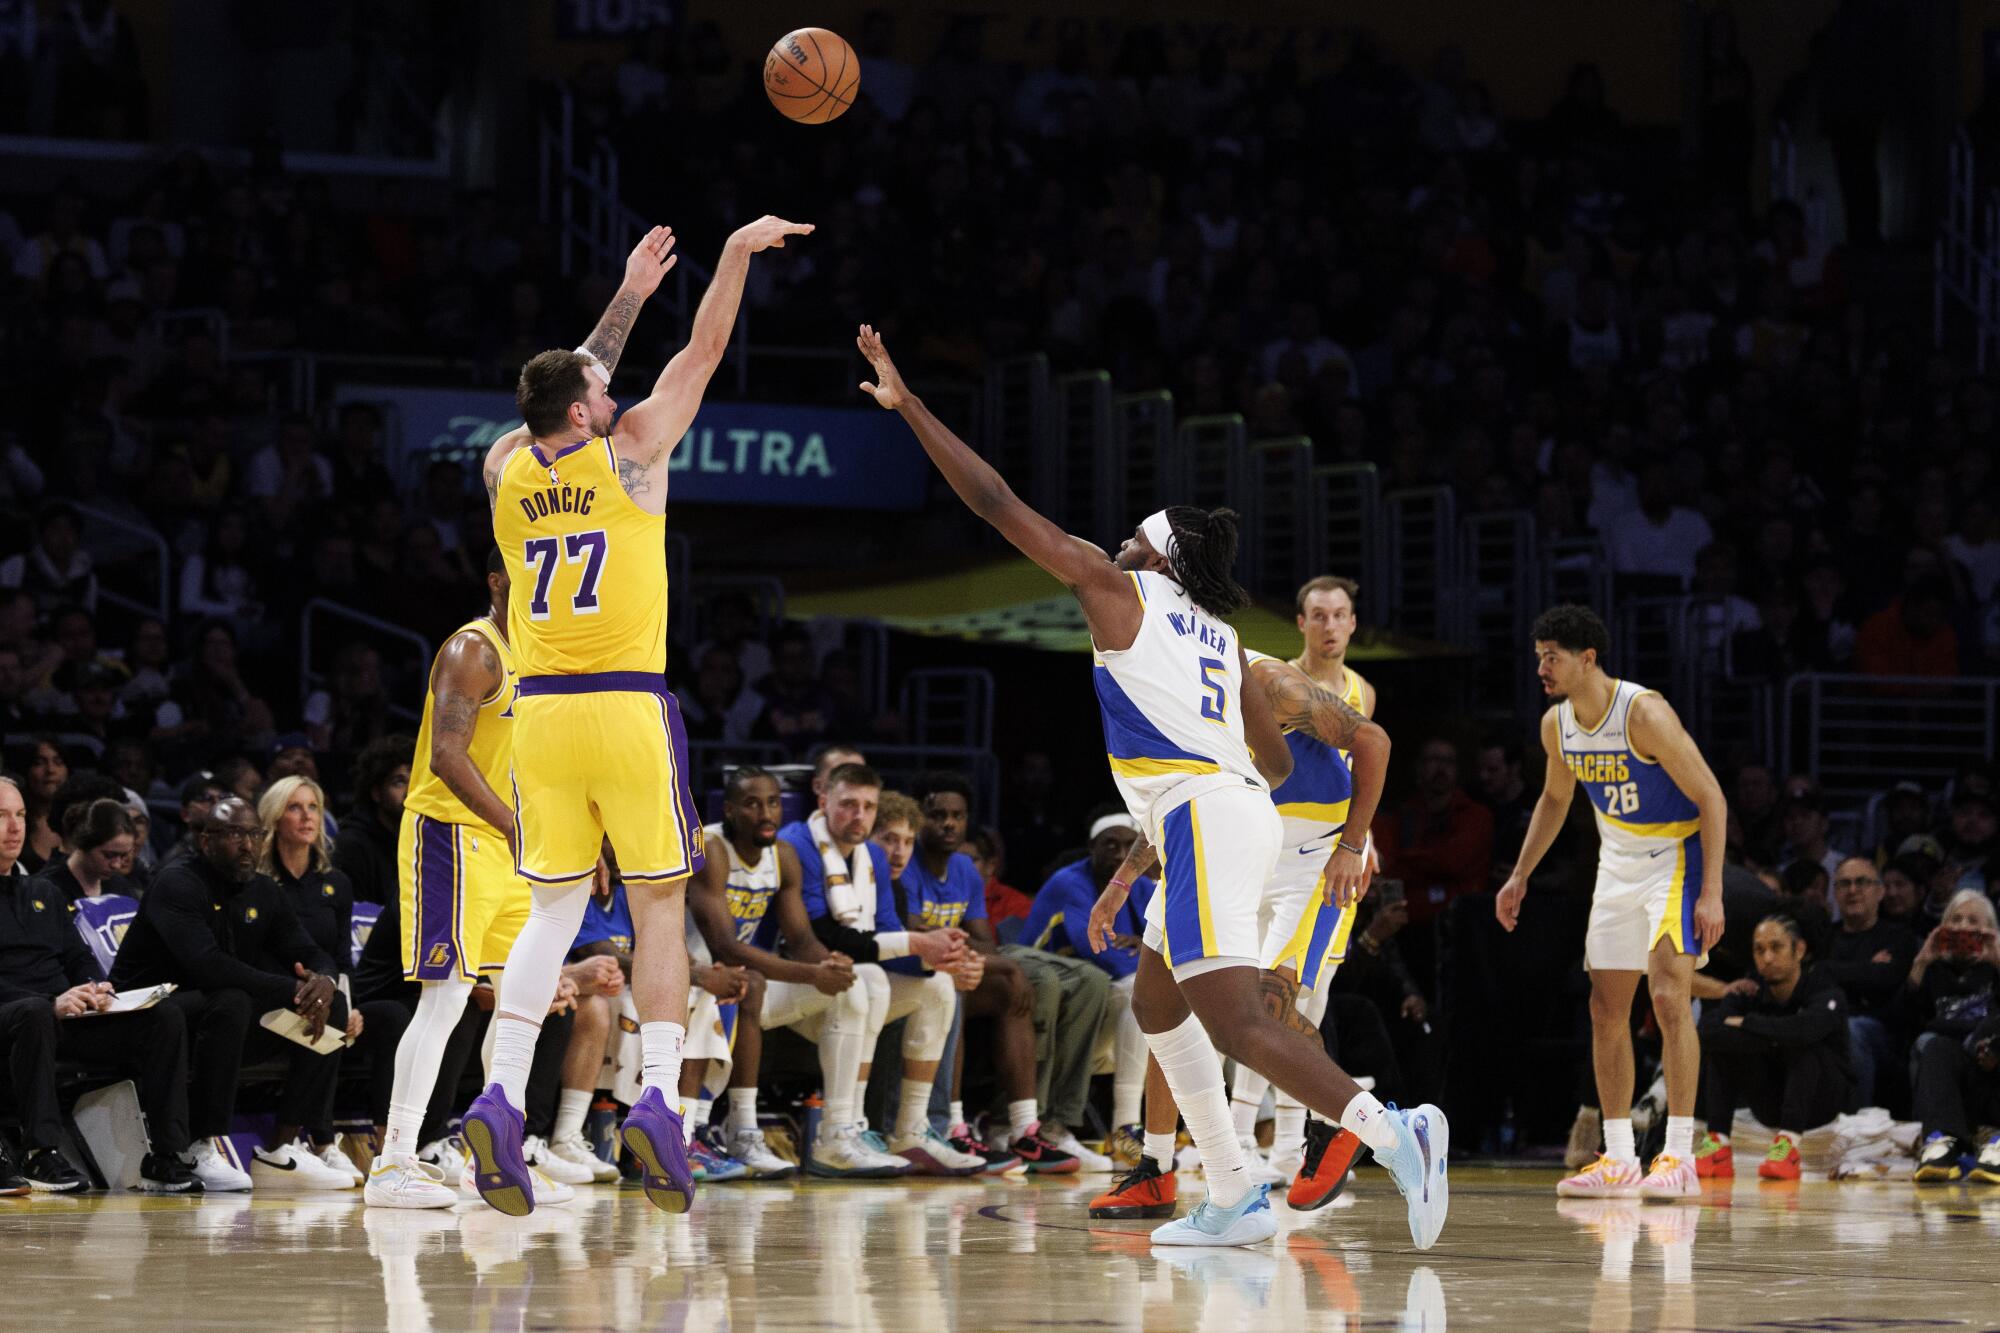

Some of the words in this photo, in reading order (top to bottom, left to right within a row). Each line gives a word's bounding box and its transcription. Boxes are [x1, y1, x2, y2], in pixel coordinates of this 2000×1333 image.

[519, 482, 598, 523] DONČIĆ
[524, 528, 609, 621] 77
[1166, 611, 1227, 656] WKER
[1199, 656, 1229, 728] 5
[1604, 782, 1640, 817] 26
